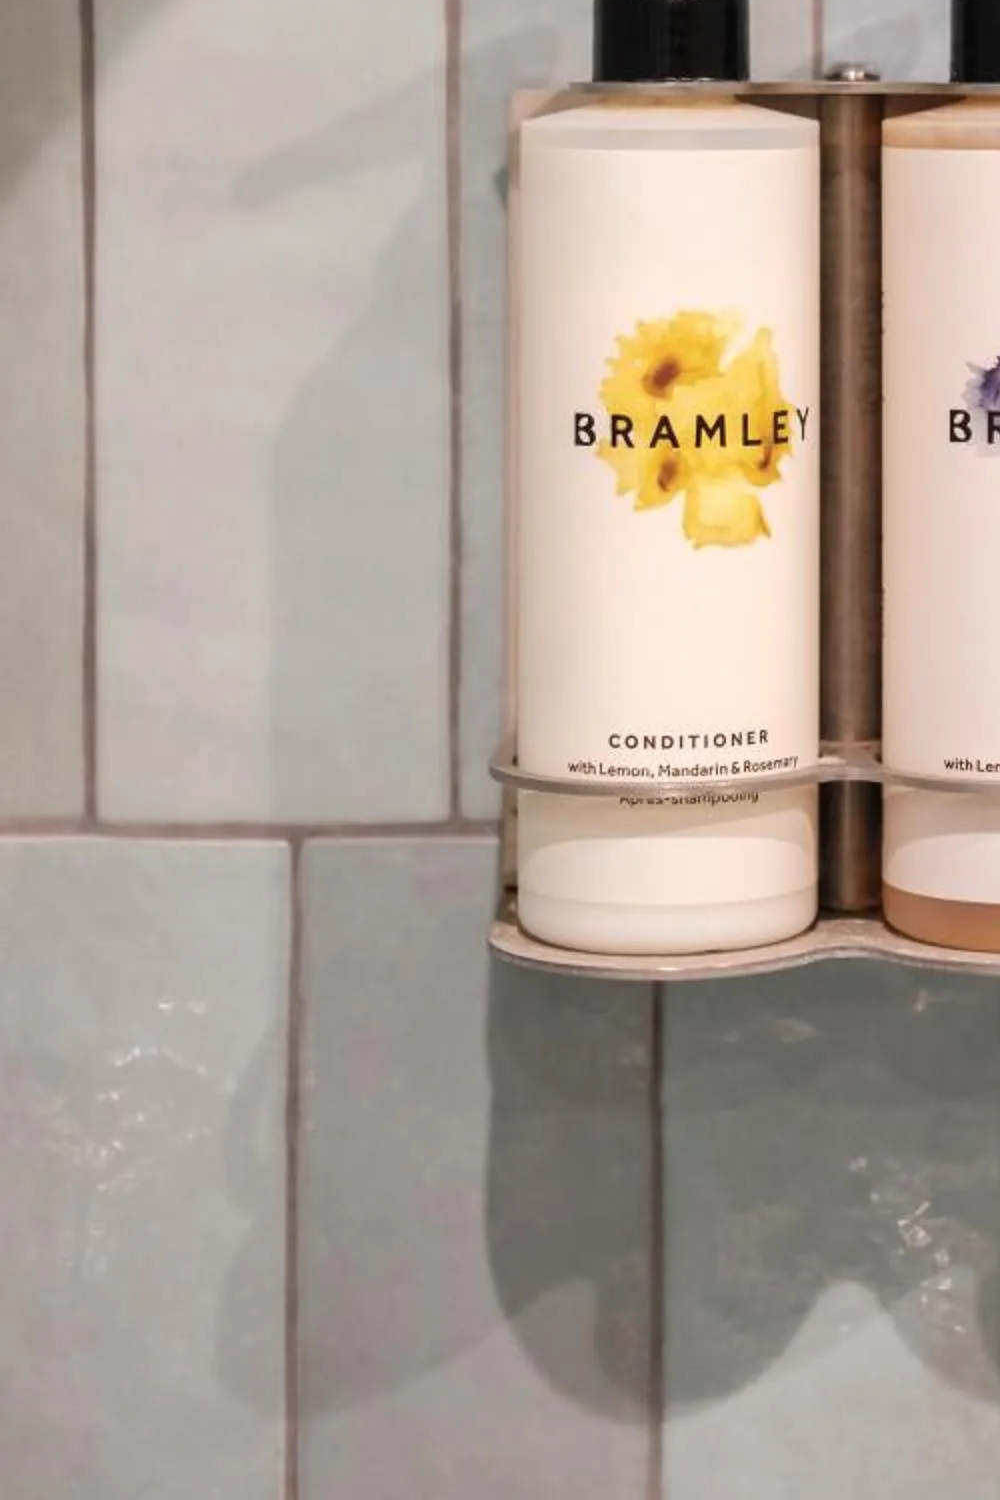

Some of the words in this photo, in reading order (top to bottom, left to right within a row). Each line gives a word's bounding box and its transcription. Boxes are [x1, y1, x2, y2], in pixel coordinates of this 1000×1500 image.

[575, 407, 809, 449] BRAMLEY
[608, 729, 769, 750] CONDITIONER
[567, 760, 597, 776] with
[600, 763, 655, 779] Lemon,
[658, 764, 729, 778] Mandarin
[731, 761, 741, 775] &
[744, 755, 799, 774] Rosemary
[944, 757, 973, 772] with
